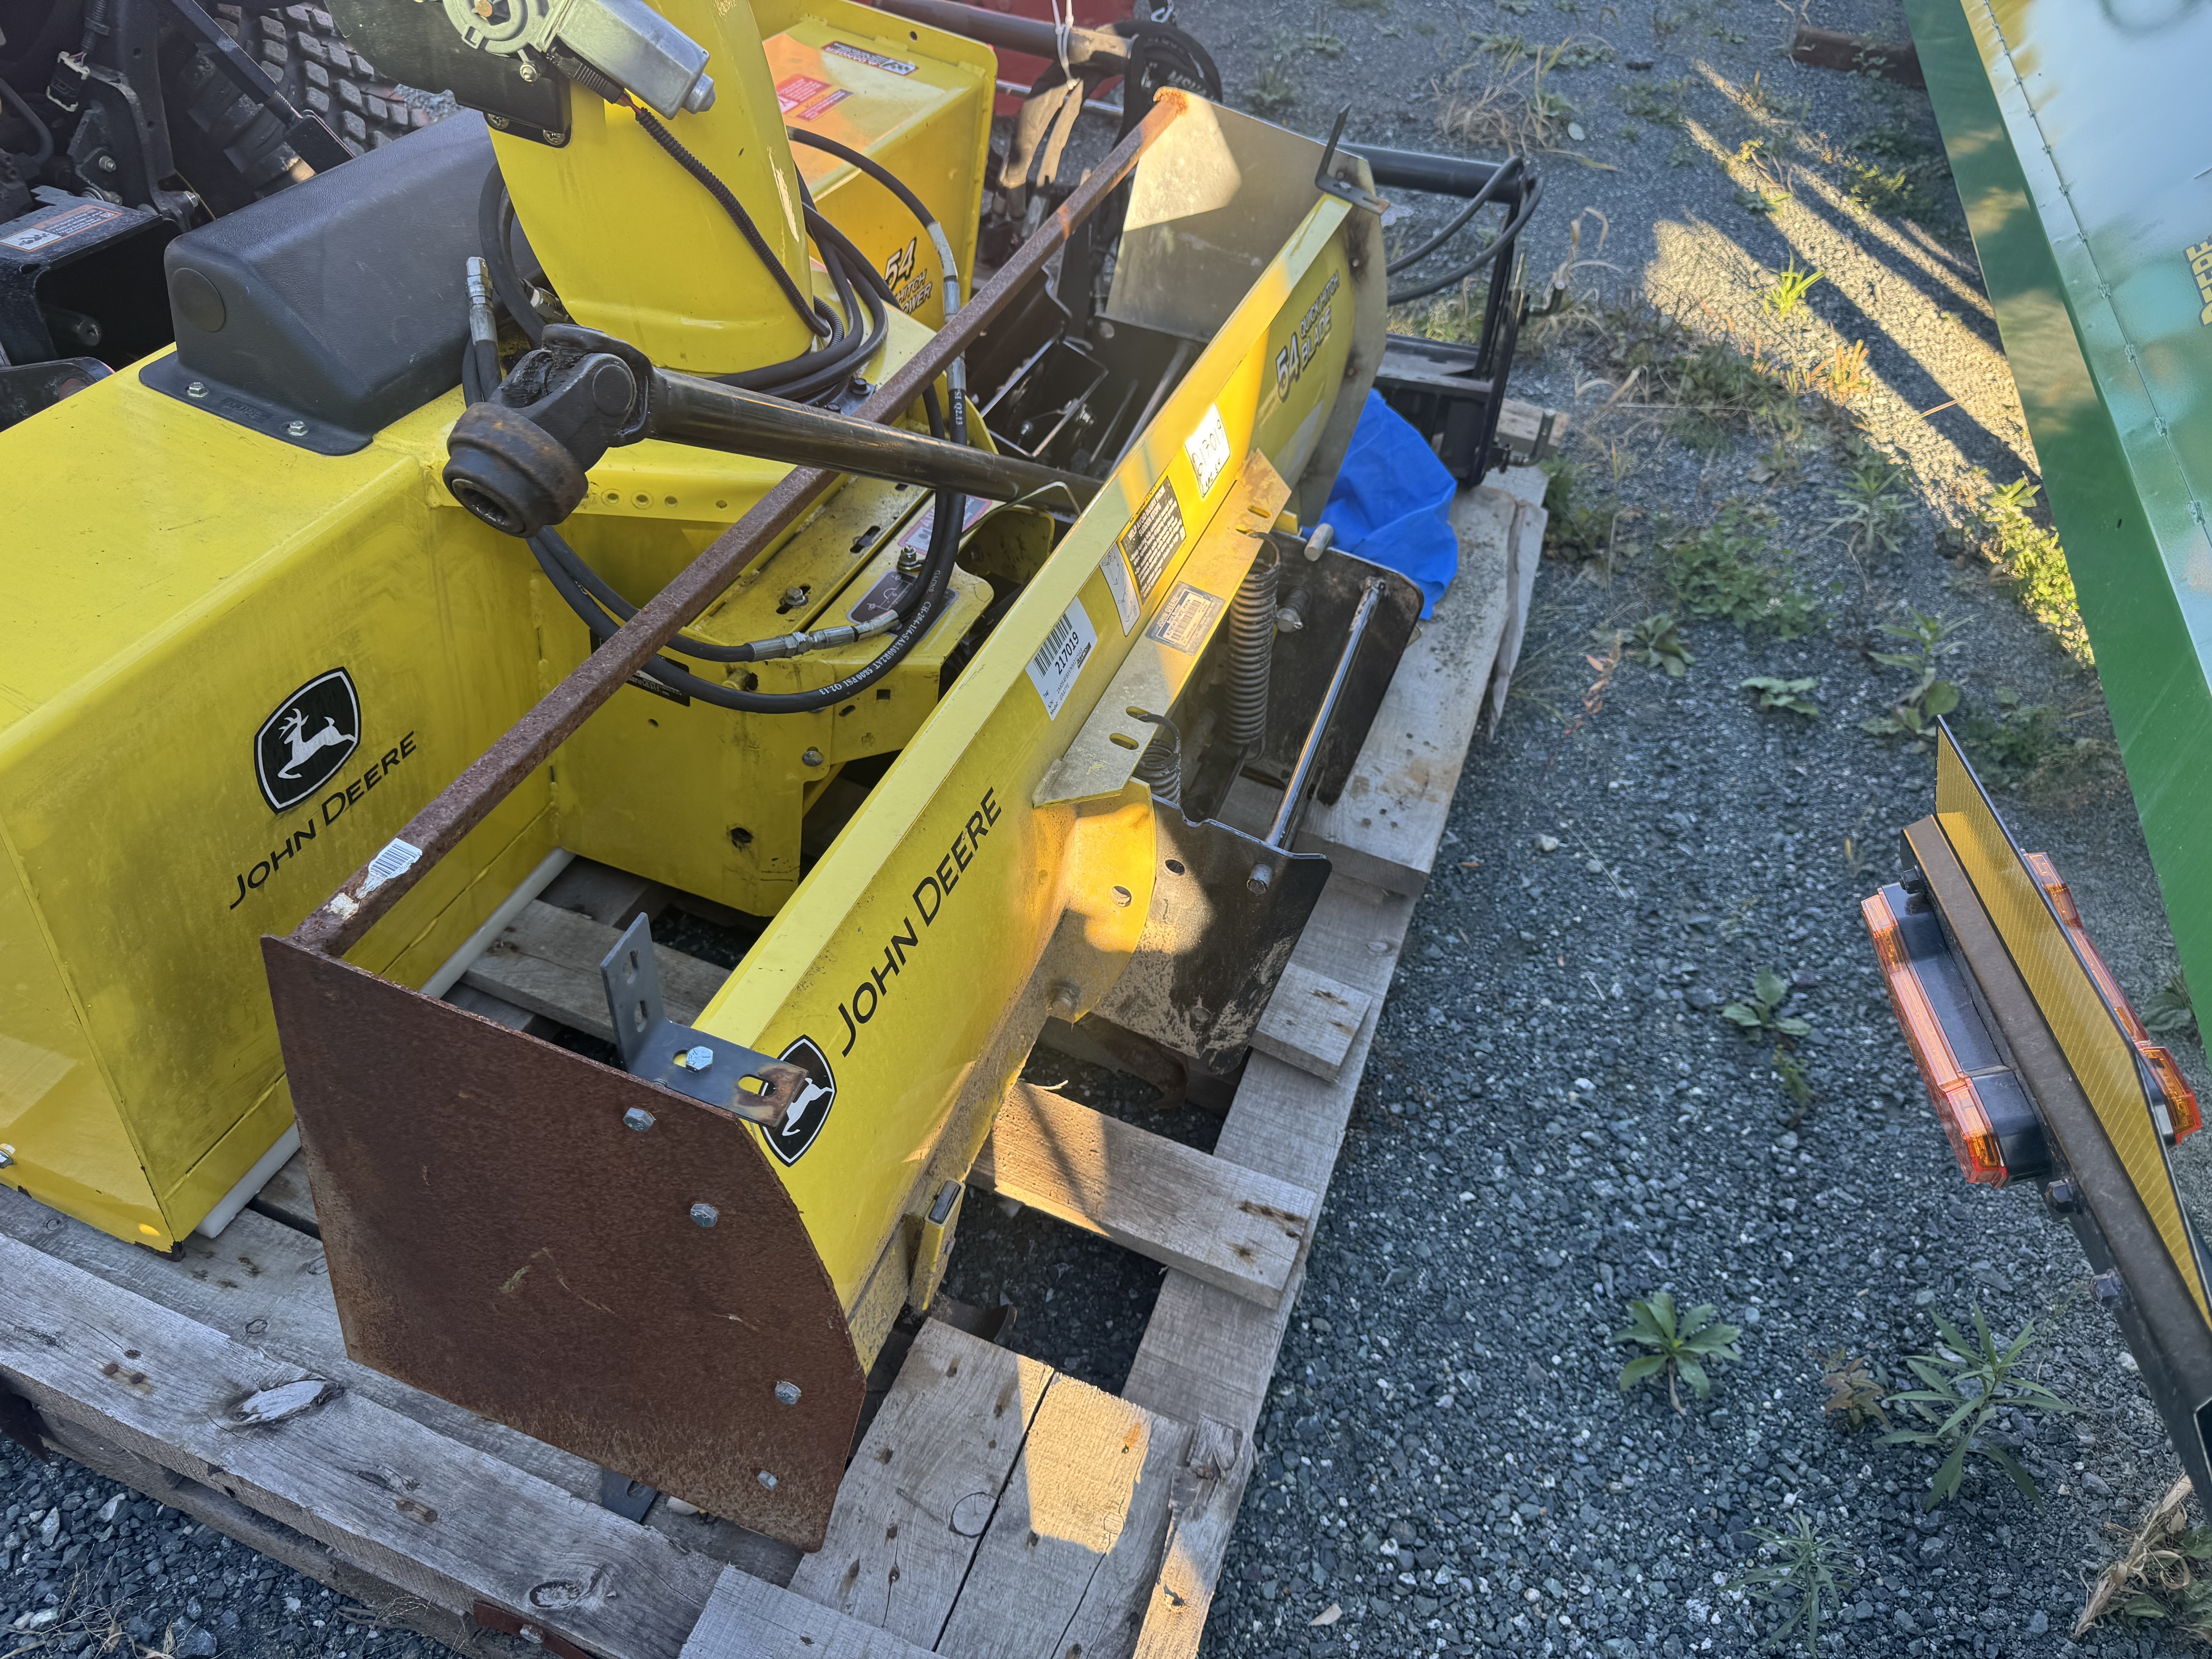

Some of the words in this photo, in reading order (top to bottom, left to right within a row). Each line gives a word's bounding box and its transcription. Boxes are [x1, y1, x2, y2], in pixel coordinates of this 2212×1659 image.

[885, 236, 917, 290] 54
[902, 282, 933, 315] OWER
[1301, 305, 1331, 373] BLADE
[1276, 331, 1301, 403] 54
[1128, 524, 1138, 542] HELP
[1136, 511, 1147, 529] AVOID
[1138, 515, 1152, 538] SUDDEN
[1150, 501, 1161, 521] STOPS
[1156, 612, 1169, 627] JOHN
[1164, 595, 1179, 612] DEERE
[1054, 631, 1079, 675] 217019
[819, 683, 842, 695] Q2.13
[843, 677, 859, 687] PSI
[856, 667, 874, 680] 5800
[230, 818, 316, 910] JOHN
[321, 730, 417, 826] DEERE
[838, 916, 919, 1058] JOHN
[912, 786, 1002, 927] DEERE
